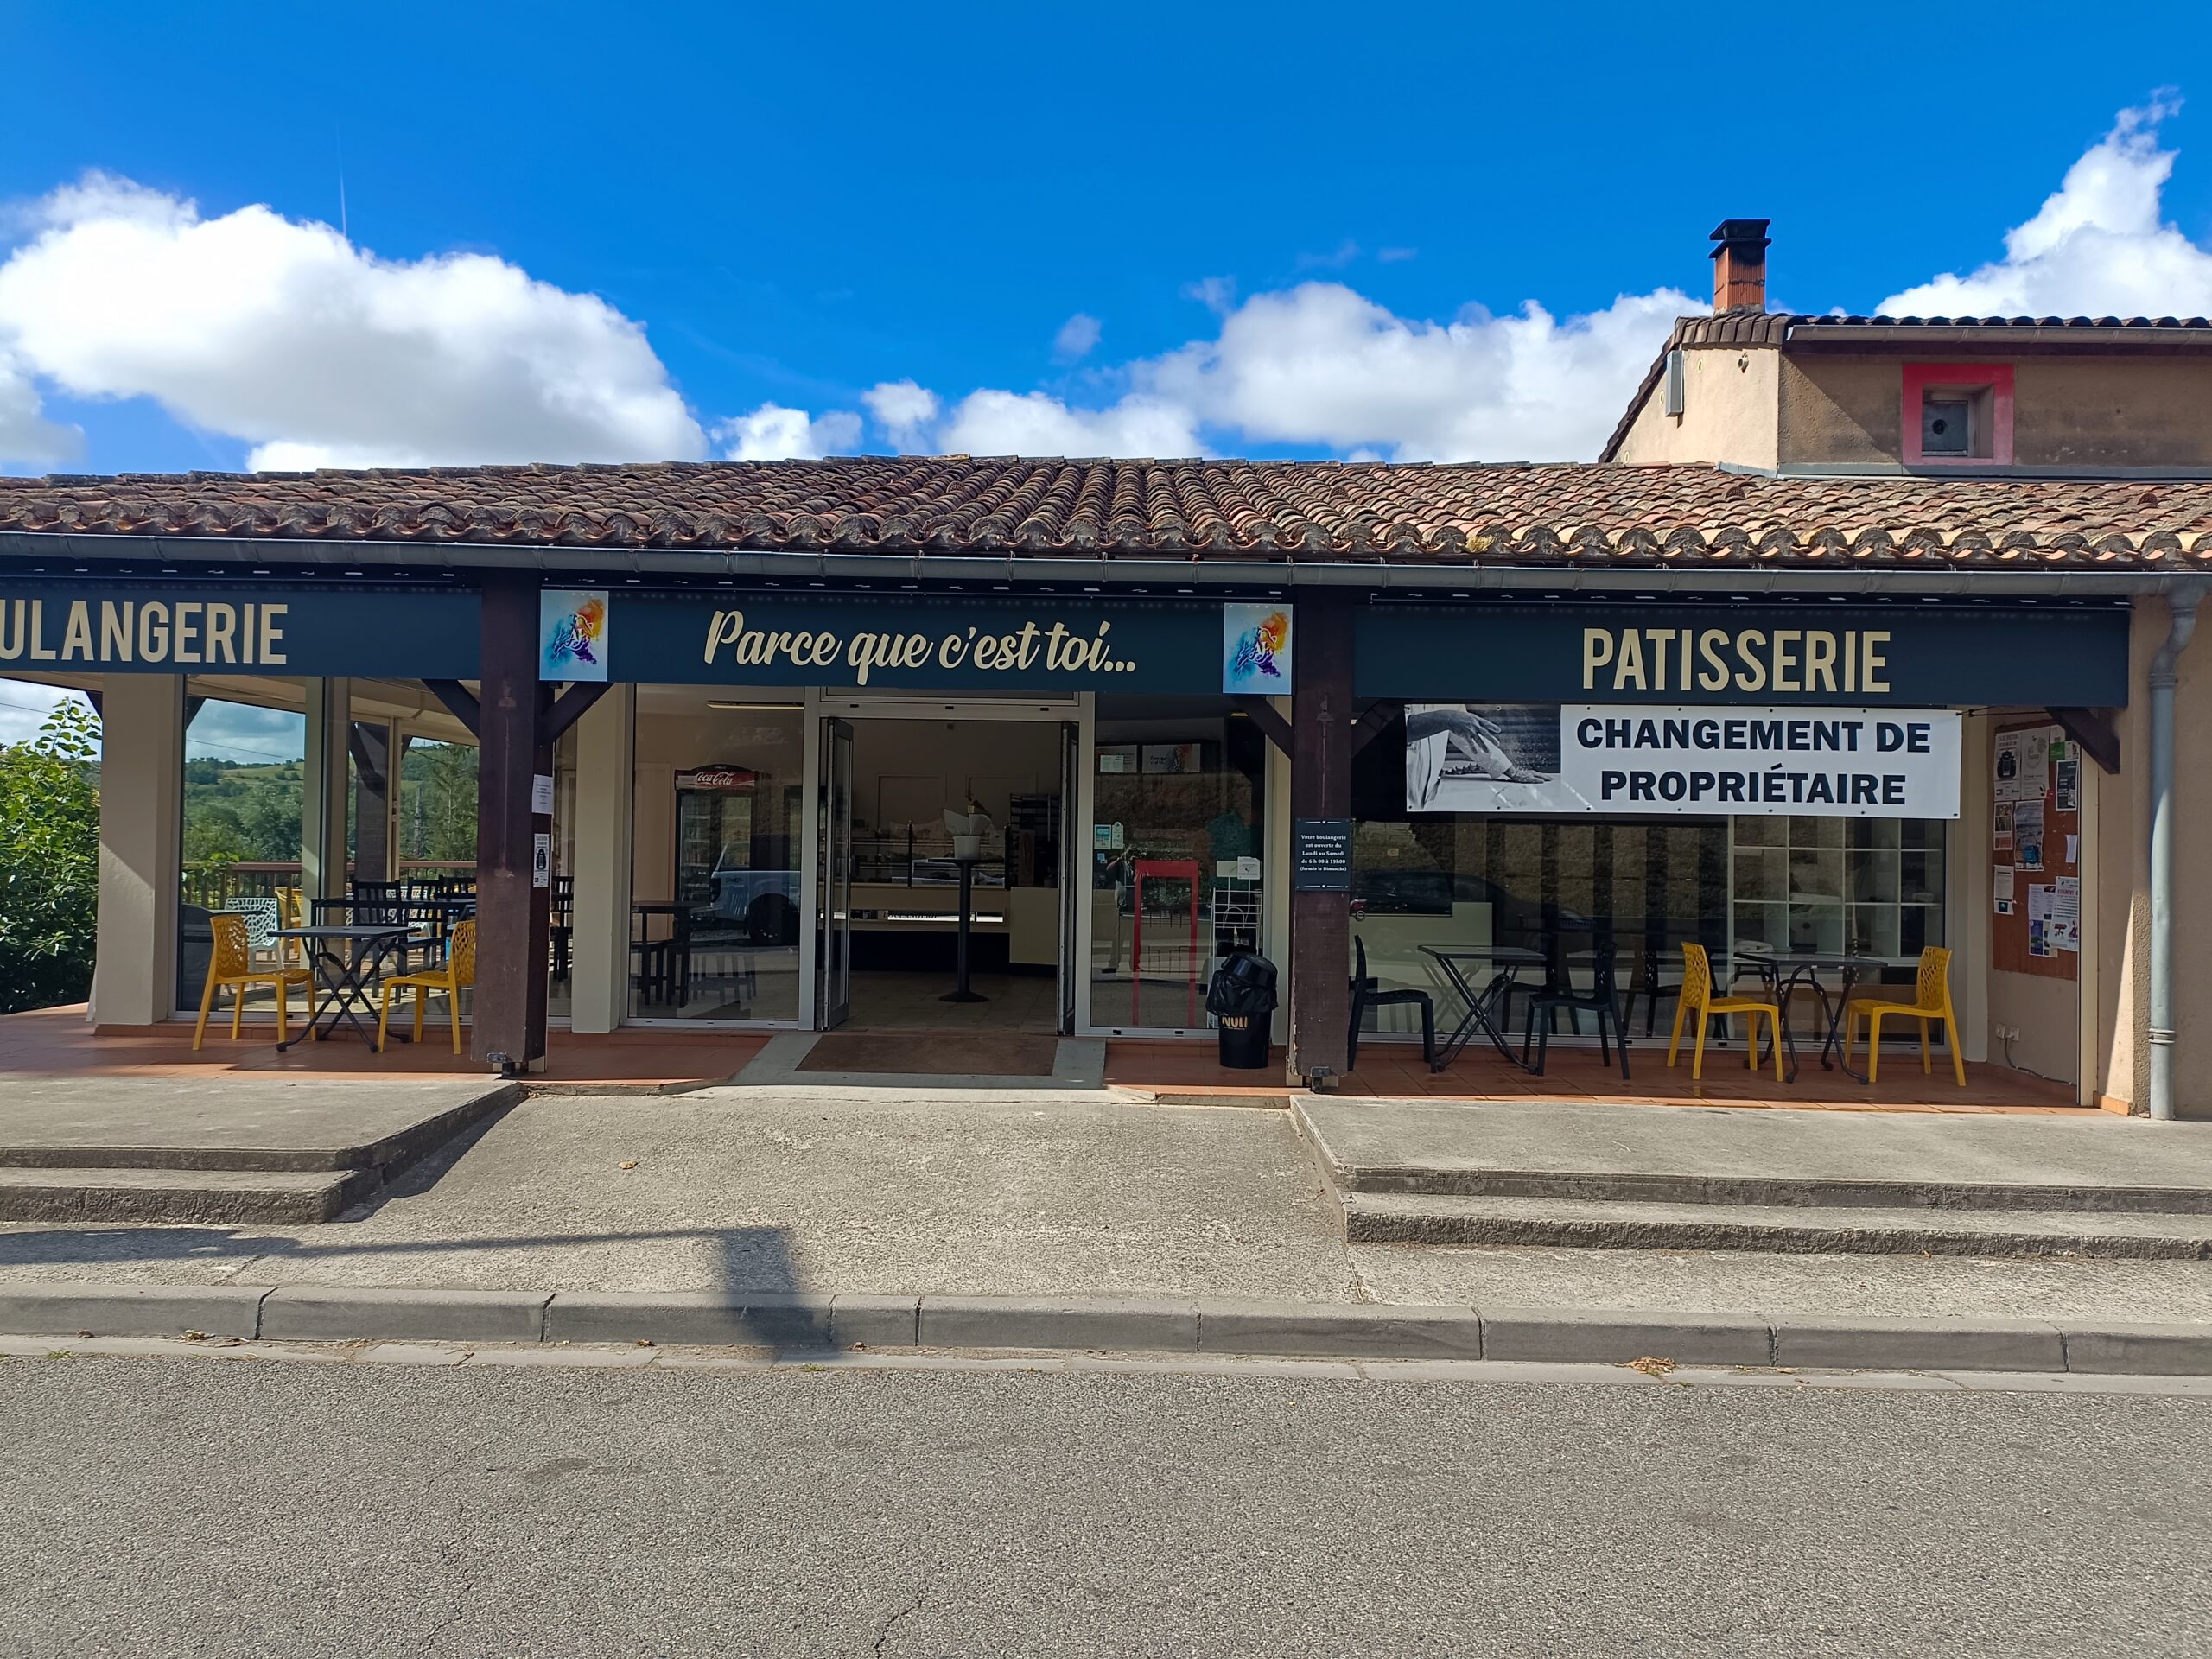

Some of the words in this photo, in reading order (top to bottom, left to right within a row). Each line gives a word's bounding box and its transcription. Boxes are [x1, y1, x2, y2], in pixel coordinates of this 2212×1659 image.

[704, 609, 843, 666] Parce
[848, 632, 934, 686] que
[939, 620, 1041, 670] c'est
[1044, 620, 1136, 672] toi...
[1583, 627, 1891, 694] PATISSERIE
[1576, 718, 1864, 752] CHANGEMENT
[1875, 721, 1932, 753] DE
[1600, 763, 1907, 805] PROPRIÉTAIRE
